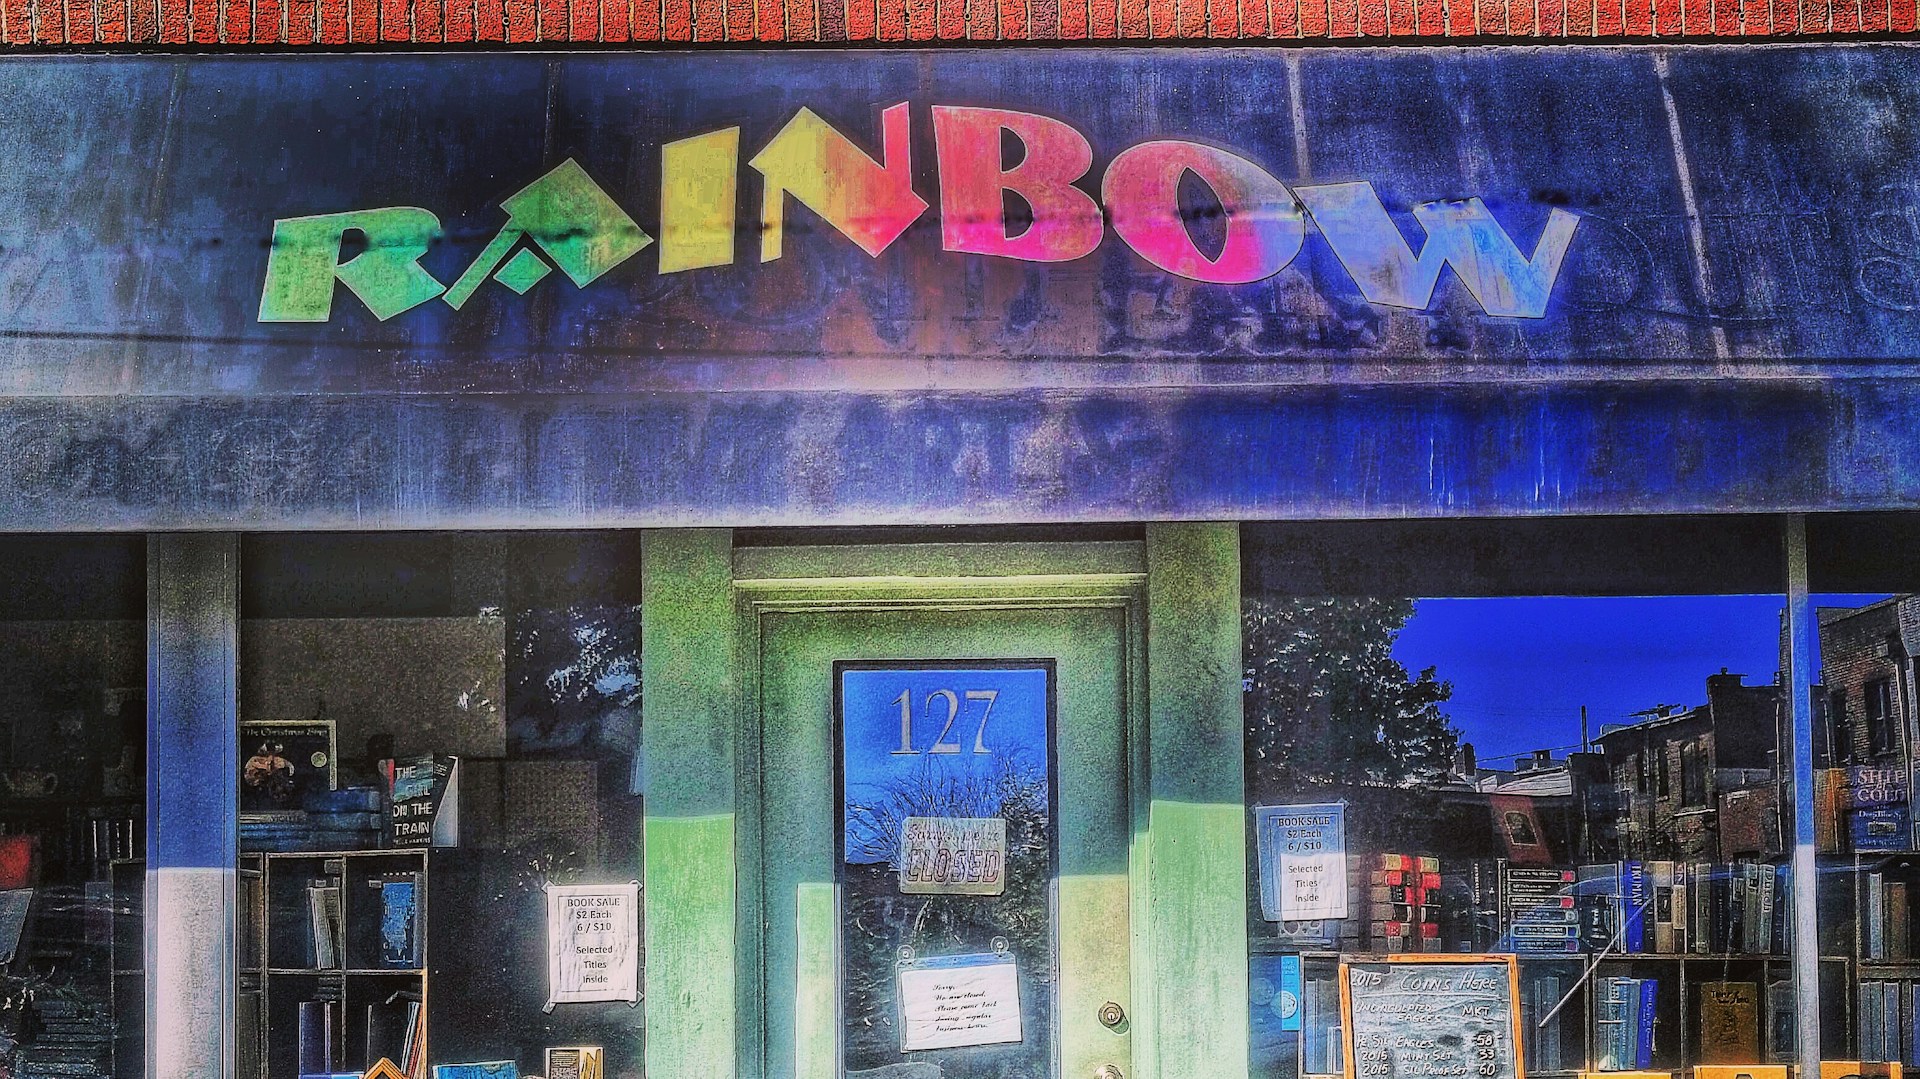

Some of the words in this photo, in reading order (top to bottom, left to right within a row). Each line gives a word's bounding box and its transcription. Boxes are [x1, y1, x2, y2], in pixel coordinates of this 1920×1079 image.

[258, 101, 1581, 321] RAINBOW
[890, 689, 1000, 754] 127
[395, 765, 417, 779] THE
[393, 805, 408, 817] ON
[411, 802, 433, 815] THE
[1278, 818, 1305, 828] BOOK
[1307, 816, 1330, 826] SALE
[395, 821, 430, 836] TRAIN
[1287, 829, 1299, 839] $2
[1301, 829, 1321, 838] Each
[1288, 842, 1294, 851] 6
[1303, 841, 1322, 850] $10
[906, 848, 1001, 883] CLOSED
[1288, 865, 1324, 874] Selected
[1295, 880, 1318, 889] Titles
[1631, 864, 1643, 907] TRUMAN
[567, 898, 594, 908] BOOK
[596, 897, 620, 907] SALE
[1295, 894, 1319, 903] Inside
[576, 910, 588, 920] $2
[590, 910, 612, 919] Each
[577, 923, 583, 932] 6
[593, 922, 612, 931] $10
[576, 945, 613, 954] Selected
[583, 960, 607, 969] Titles
[582, 975, 608, 984] Inside
[1350, 971, 1382, 987] 2015
[1400, 971, 1451, 991] COINS
[1458, 971, 1498, 990] HERE
[1461, 1004, 1490, 1017] MKT
[1360, 1050, 1388, 1061] 2015
[1478, 1049, 1495, 1060] 33
[1361, 1063, 1389, 1076] 2015
[1479, 1062, 1496, 1076] 60
